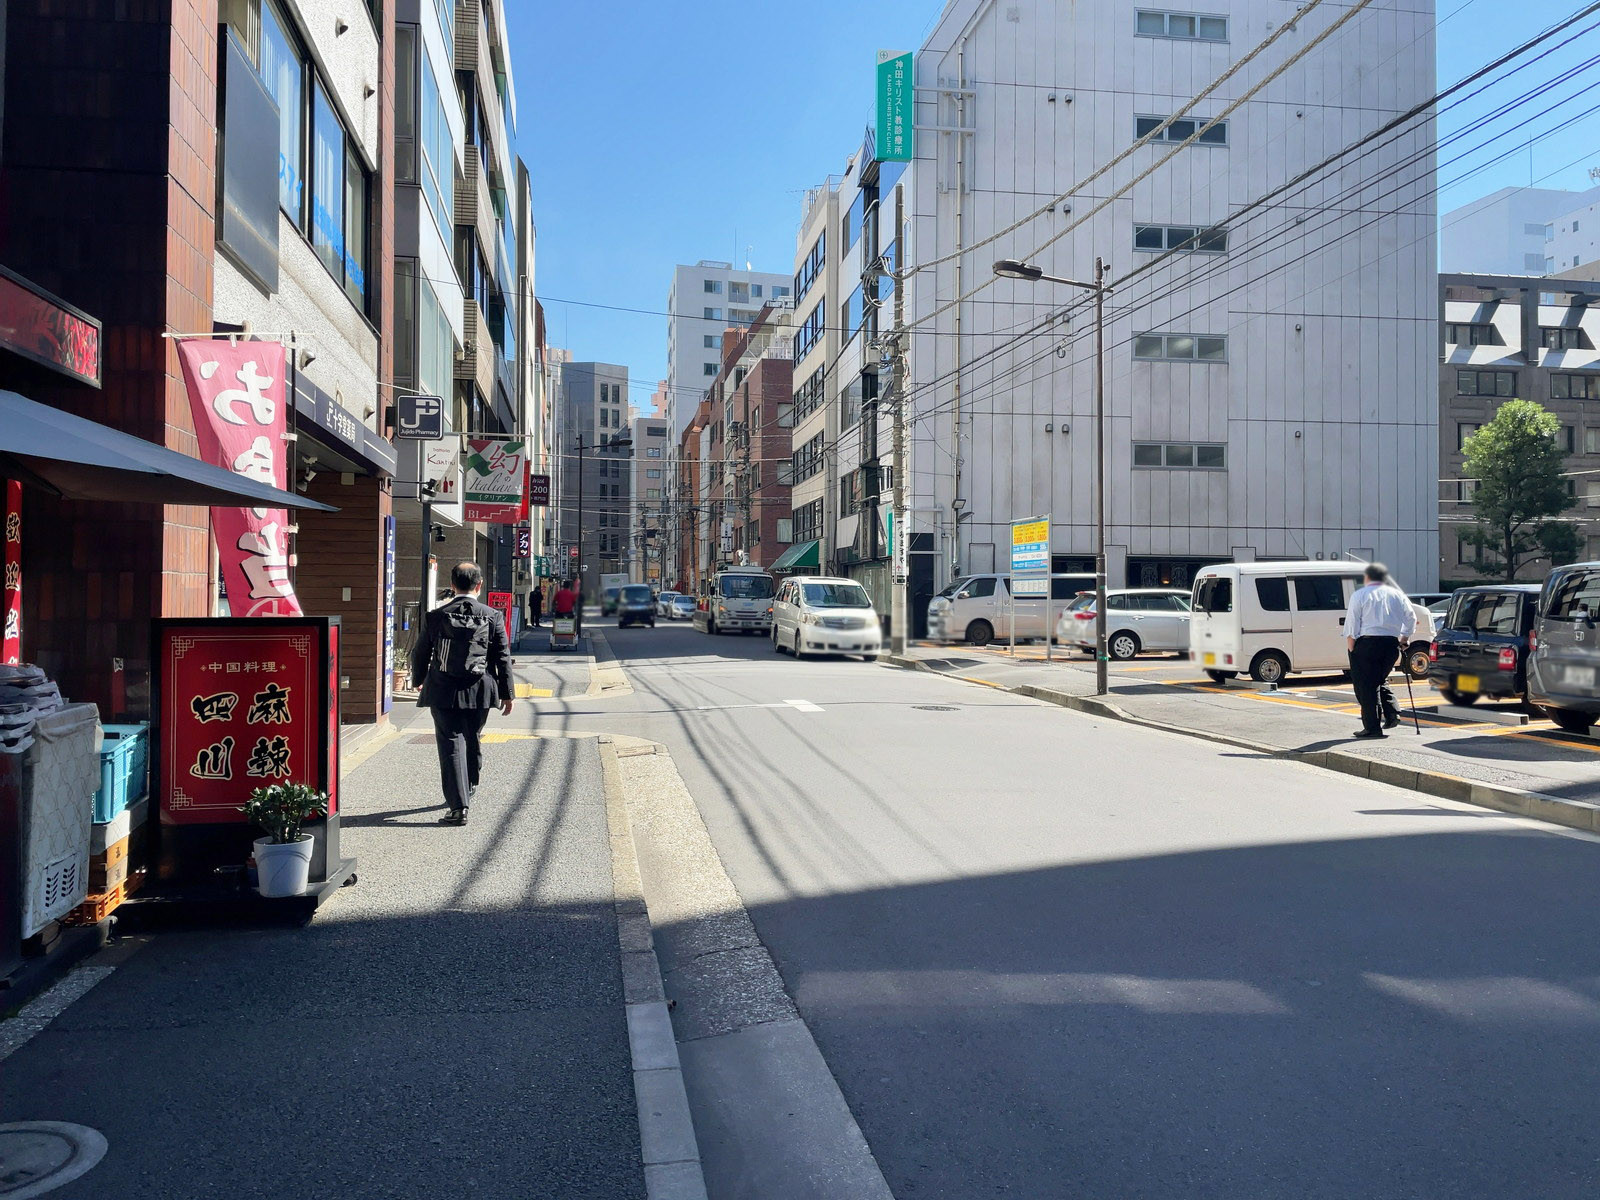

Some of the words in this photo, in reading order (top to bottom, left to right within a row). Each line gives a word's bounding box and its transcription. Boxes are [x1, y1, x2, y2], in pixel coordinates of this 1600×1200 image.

[894, 60, 904, 155] 神田キリスト教診療所
[333, 408, 356, 443] 十字堂薬局
[489, 445, 520, 475] 幻
[469, 472, 512, 493] Italian
[208, 661, 278, 674] 中国料理
